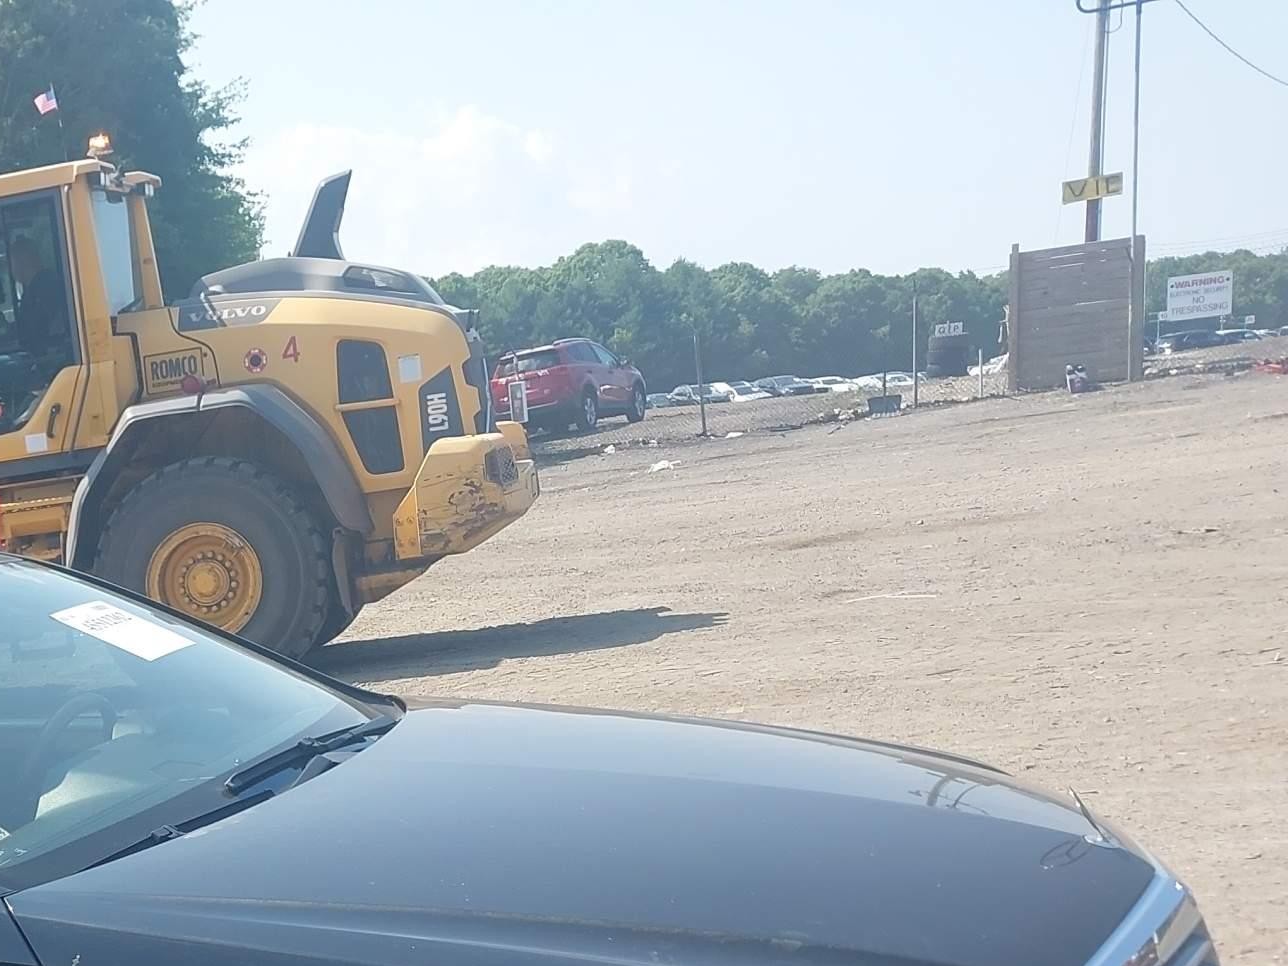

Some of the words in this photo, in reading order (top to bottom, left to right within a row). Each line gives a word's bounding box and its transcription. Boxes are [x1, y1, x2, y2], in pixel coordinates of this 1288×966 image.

[1175, 276, 1224, 289] WARNING
[1171, 302, 1228, 315] TRESPASSING
[1192, 296, 1205, 304] NO
[282, 335, 301, 362] 4
[151, 354, 197, 380] ROMCO
[426, 392, 449, 432] L90H
